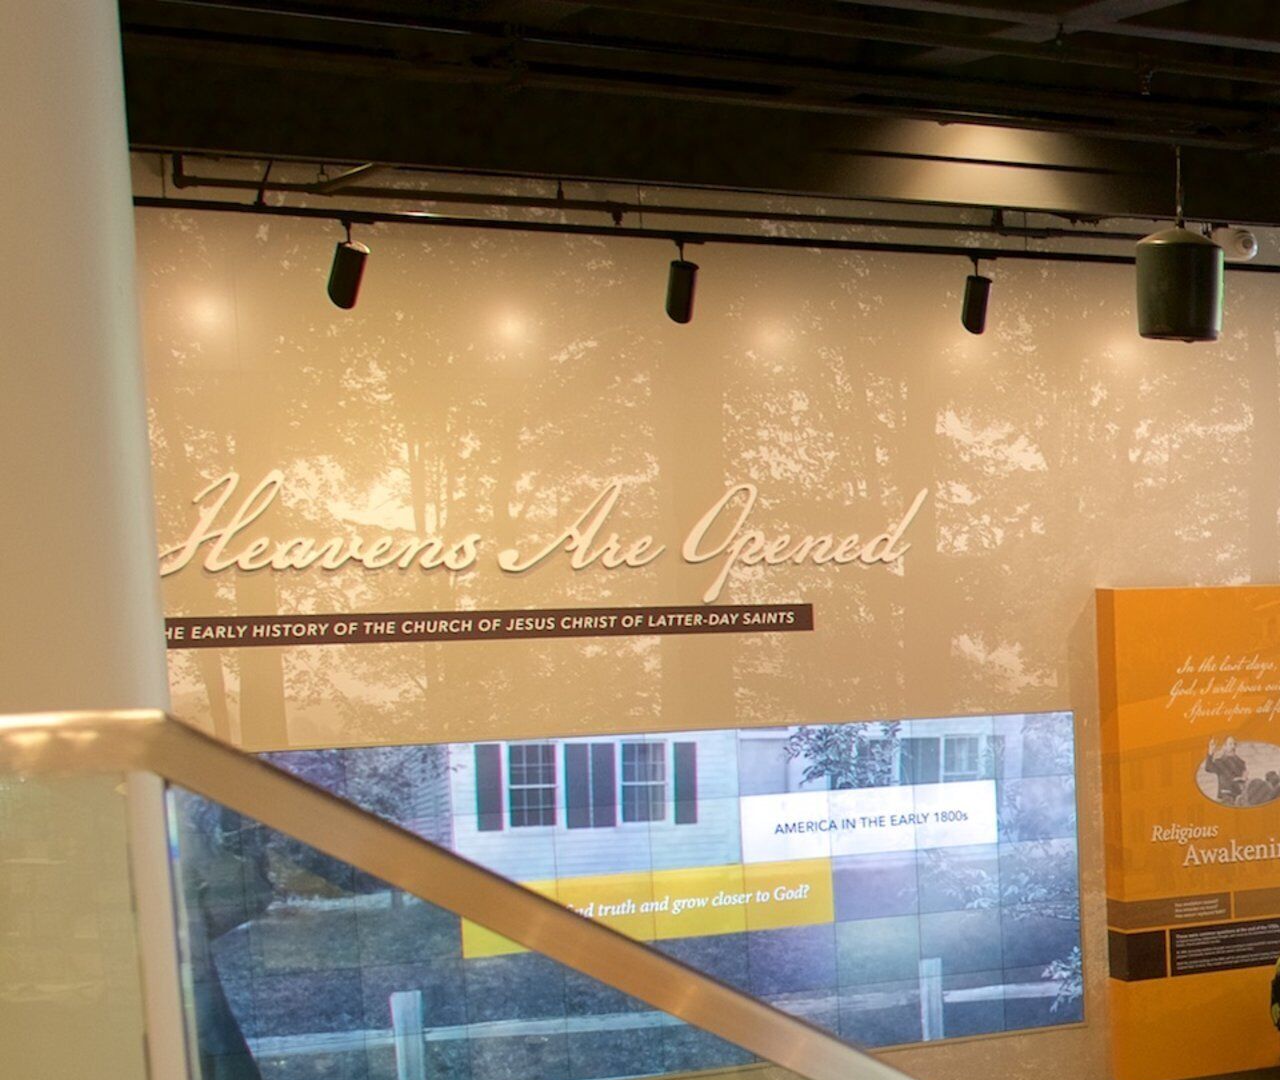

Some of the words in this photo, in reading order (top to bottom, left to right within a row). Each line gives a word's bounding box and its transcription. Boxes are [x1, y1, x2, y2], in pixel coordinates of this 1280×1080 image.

[160, 469, 481, 577] Heavens
[498, 480, 666, 572] Are
[683, 483, 928, 602] Opened
[164, 626, 185, 640] HE
[191, 624, 247, 639] EARLY
[252, 622, 329, 638] HISTORY
[333, 621, 358, 636] OF
[363, 620, 396, 635] THE
[401, 619, 473, 634] CHURCH
[478, 618, 501, 632] OF
[506, 616, 555, 631] JESUS
[560, 615, 617, 630] CHRIST
[621, 614, 644, 628] OF
[648, 612, 739, 628] LATTER-DAY
[742, 611, 795, 625] SAINTS
[1219, 655, 1246, 672] last
[775, 819, 837, 834] AMERICA
[841, 818, 856, 829] IN
[860, 815, 885, 828] THE
[890, 813, 930, 826] EARLY
[934, 810, 969, 823] 1800s
[1152, 823, 1219, 844] Religious
[598, 899, 636, 917] truth
[640, 895, 669, 912] and
[672, 896, 709, 914] grow
[712, 889, 752, 908] closer
[755, 889, 770, 903] to
[774, 884, 811, 900] God?
